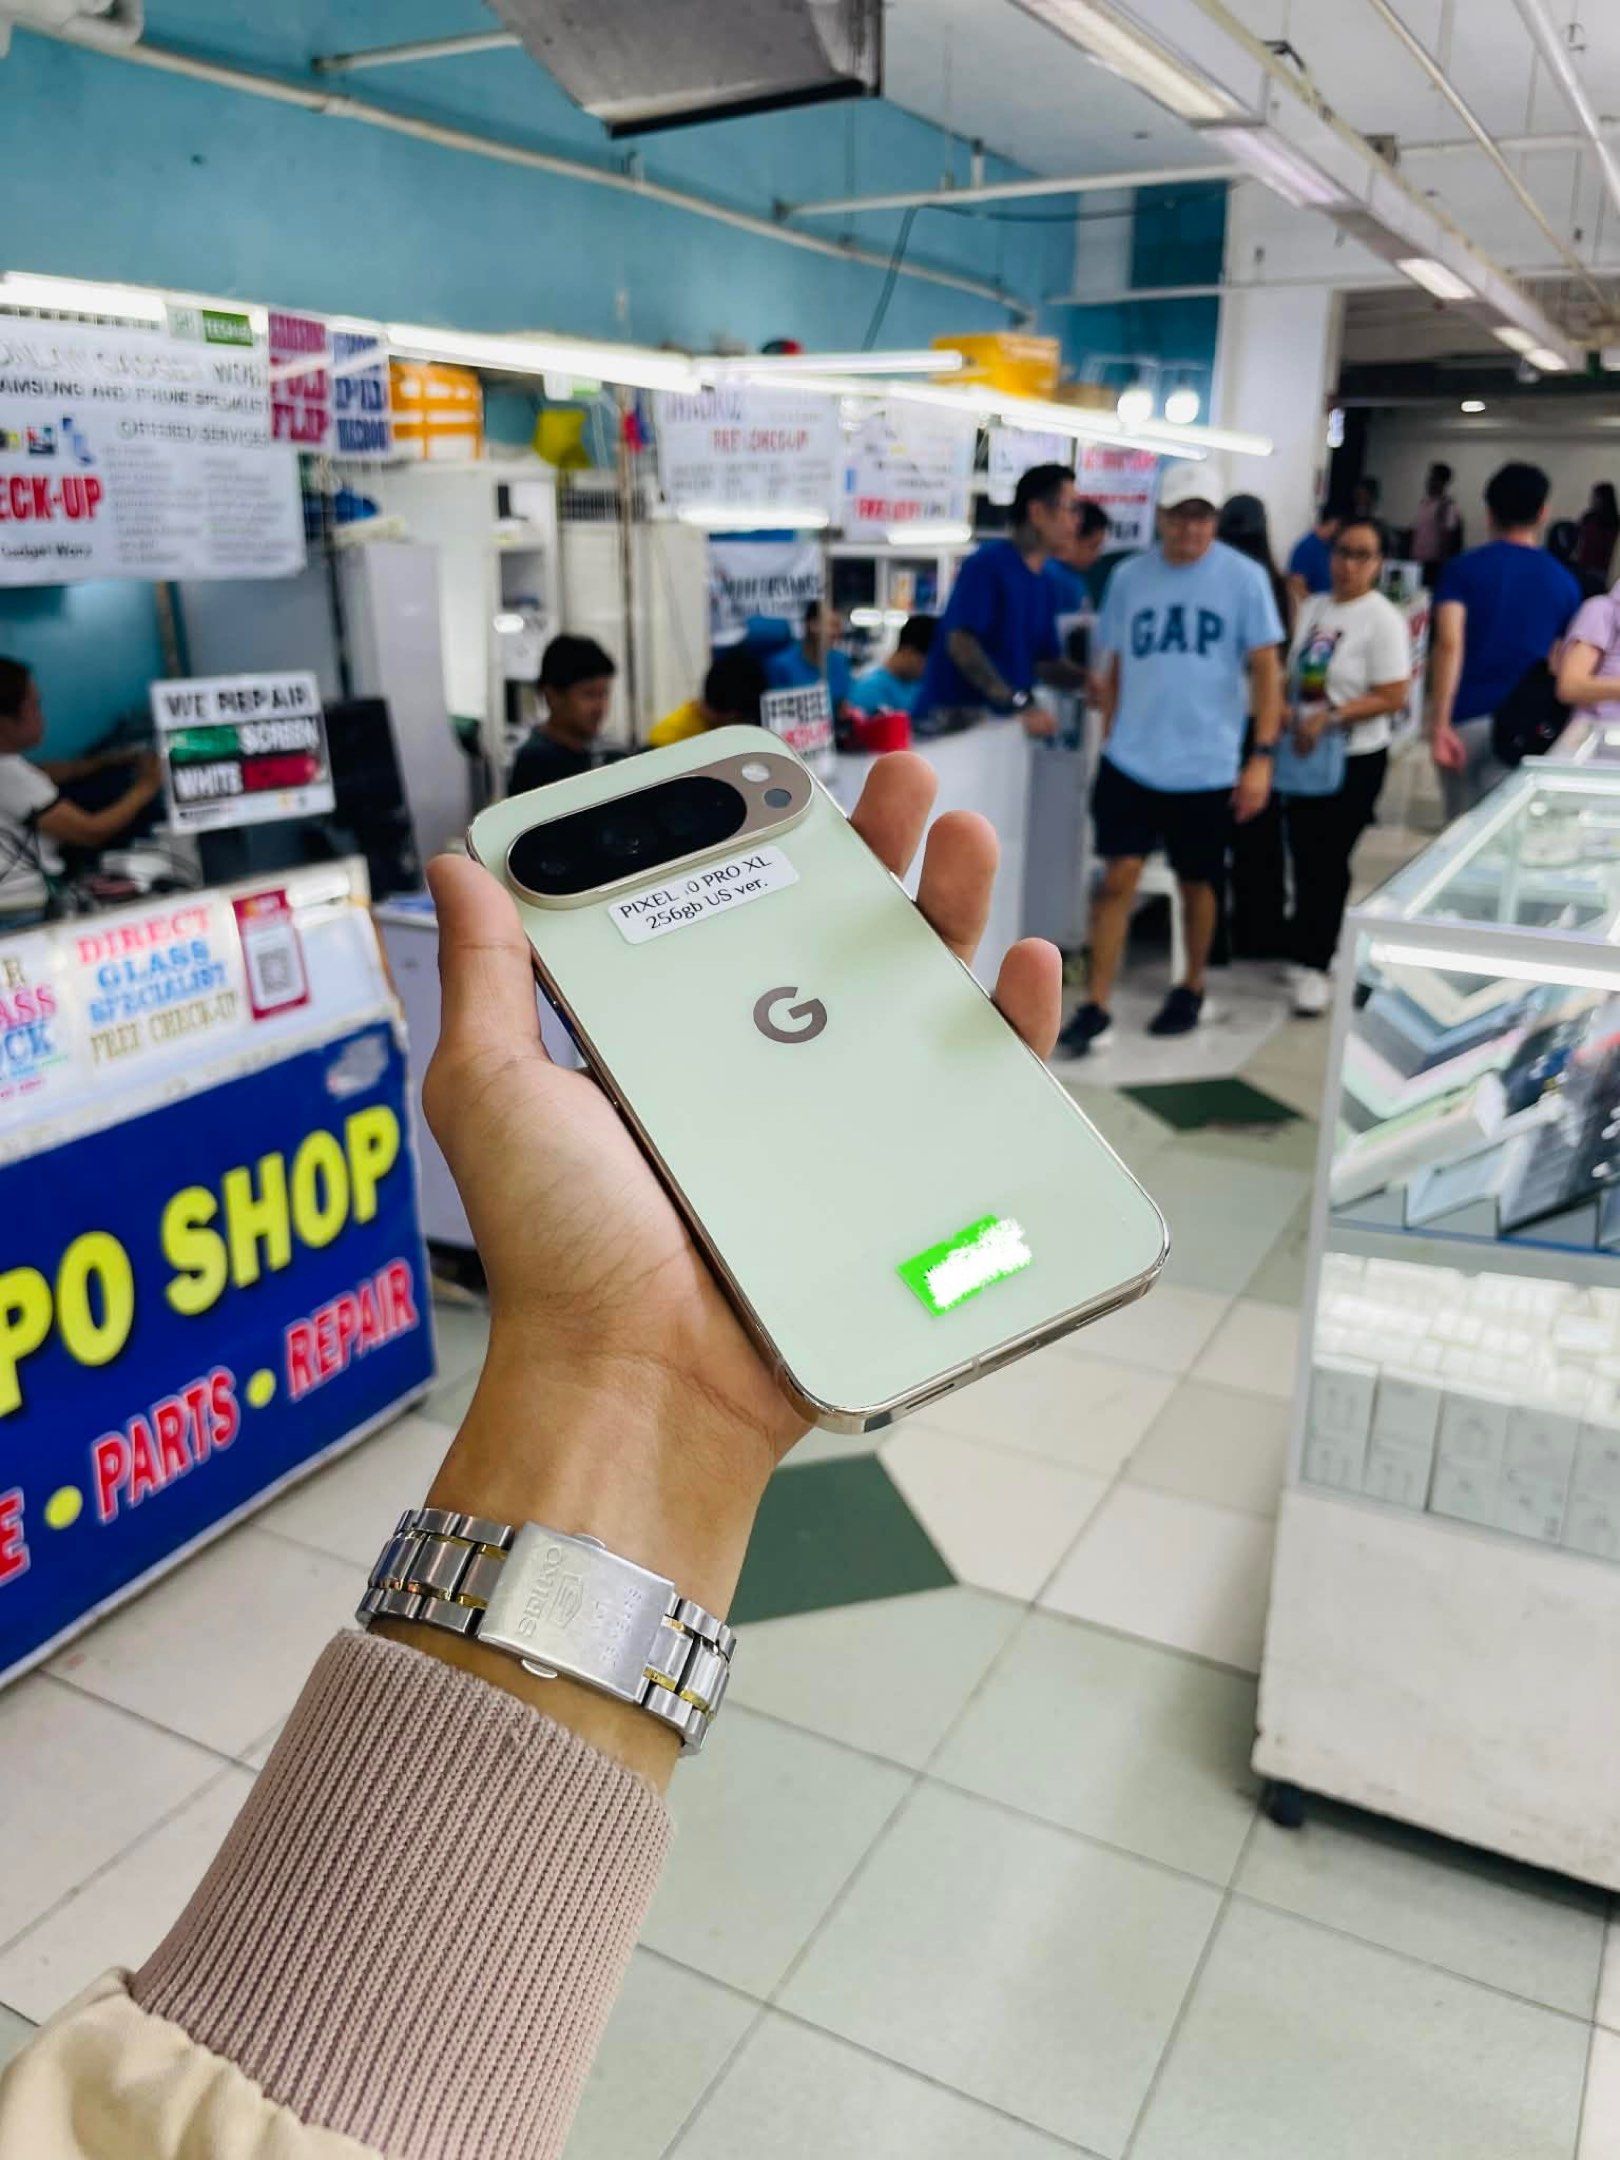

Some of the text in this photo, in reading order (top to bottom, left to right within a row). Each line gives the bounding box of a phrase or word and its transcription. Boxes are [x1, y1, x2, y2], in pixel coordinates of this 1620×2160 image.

[1131, 606, 1225, 658] GAP
[166, 684, 309, 717] WE REPAIR
[240, 717, 320, 755] SCREEN
[175, 761, 244, 801] WHITE
[619, 855, 772, 918] PIXEL 0 PRO XL
[645, 878, 769, 929] 256gb US ver.
[76, 908, 209, 964] DIRECT
[89, 959, 228, 1024] SPECIALIST
[97, 940, 209, 989] GLASS
[90, 990, 238, 1065] FREE CHECK-UP
[753, 986, 828, 1043] G
[0, 1103, 401, 1418] PO SHOP
[91, 1364, 241, 1525] PARTS
[284, 1256, 418, 1402] REPAIR
[519, 1544, 562, 1637] SEIKO
